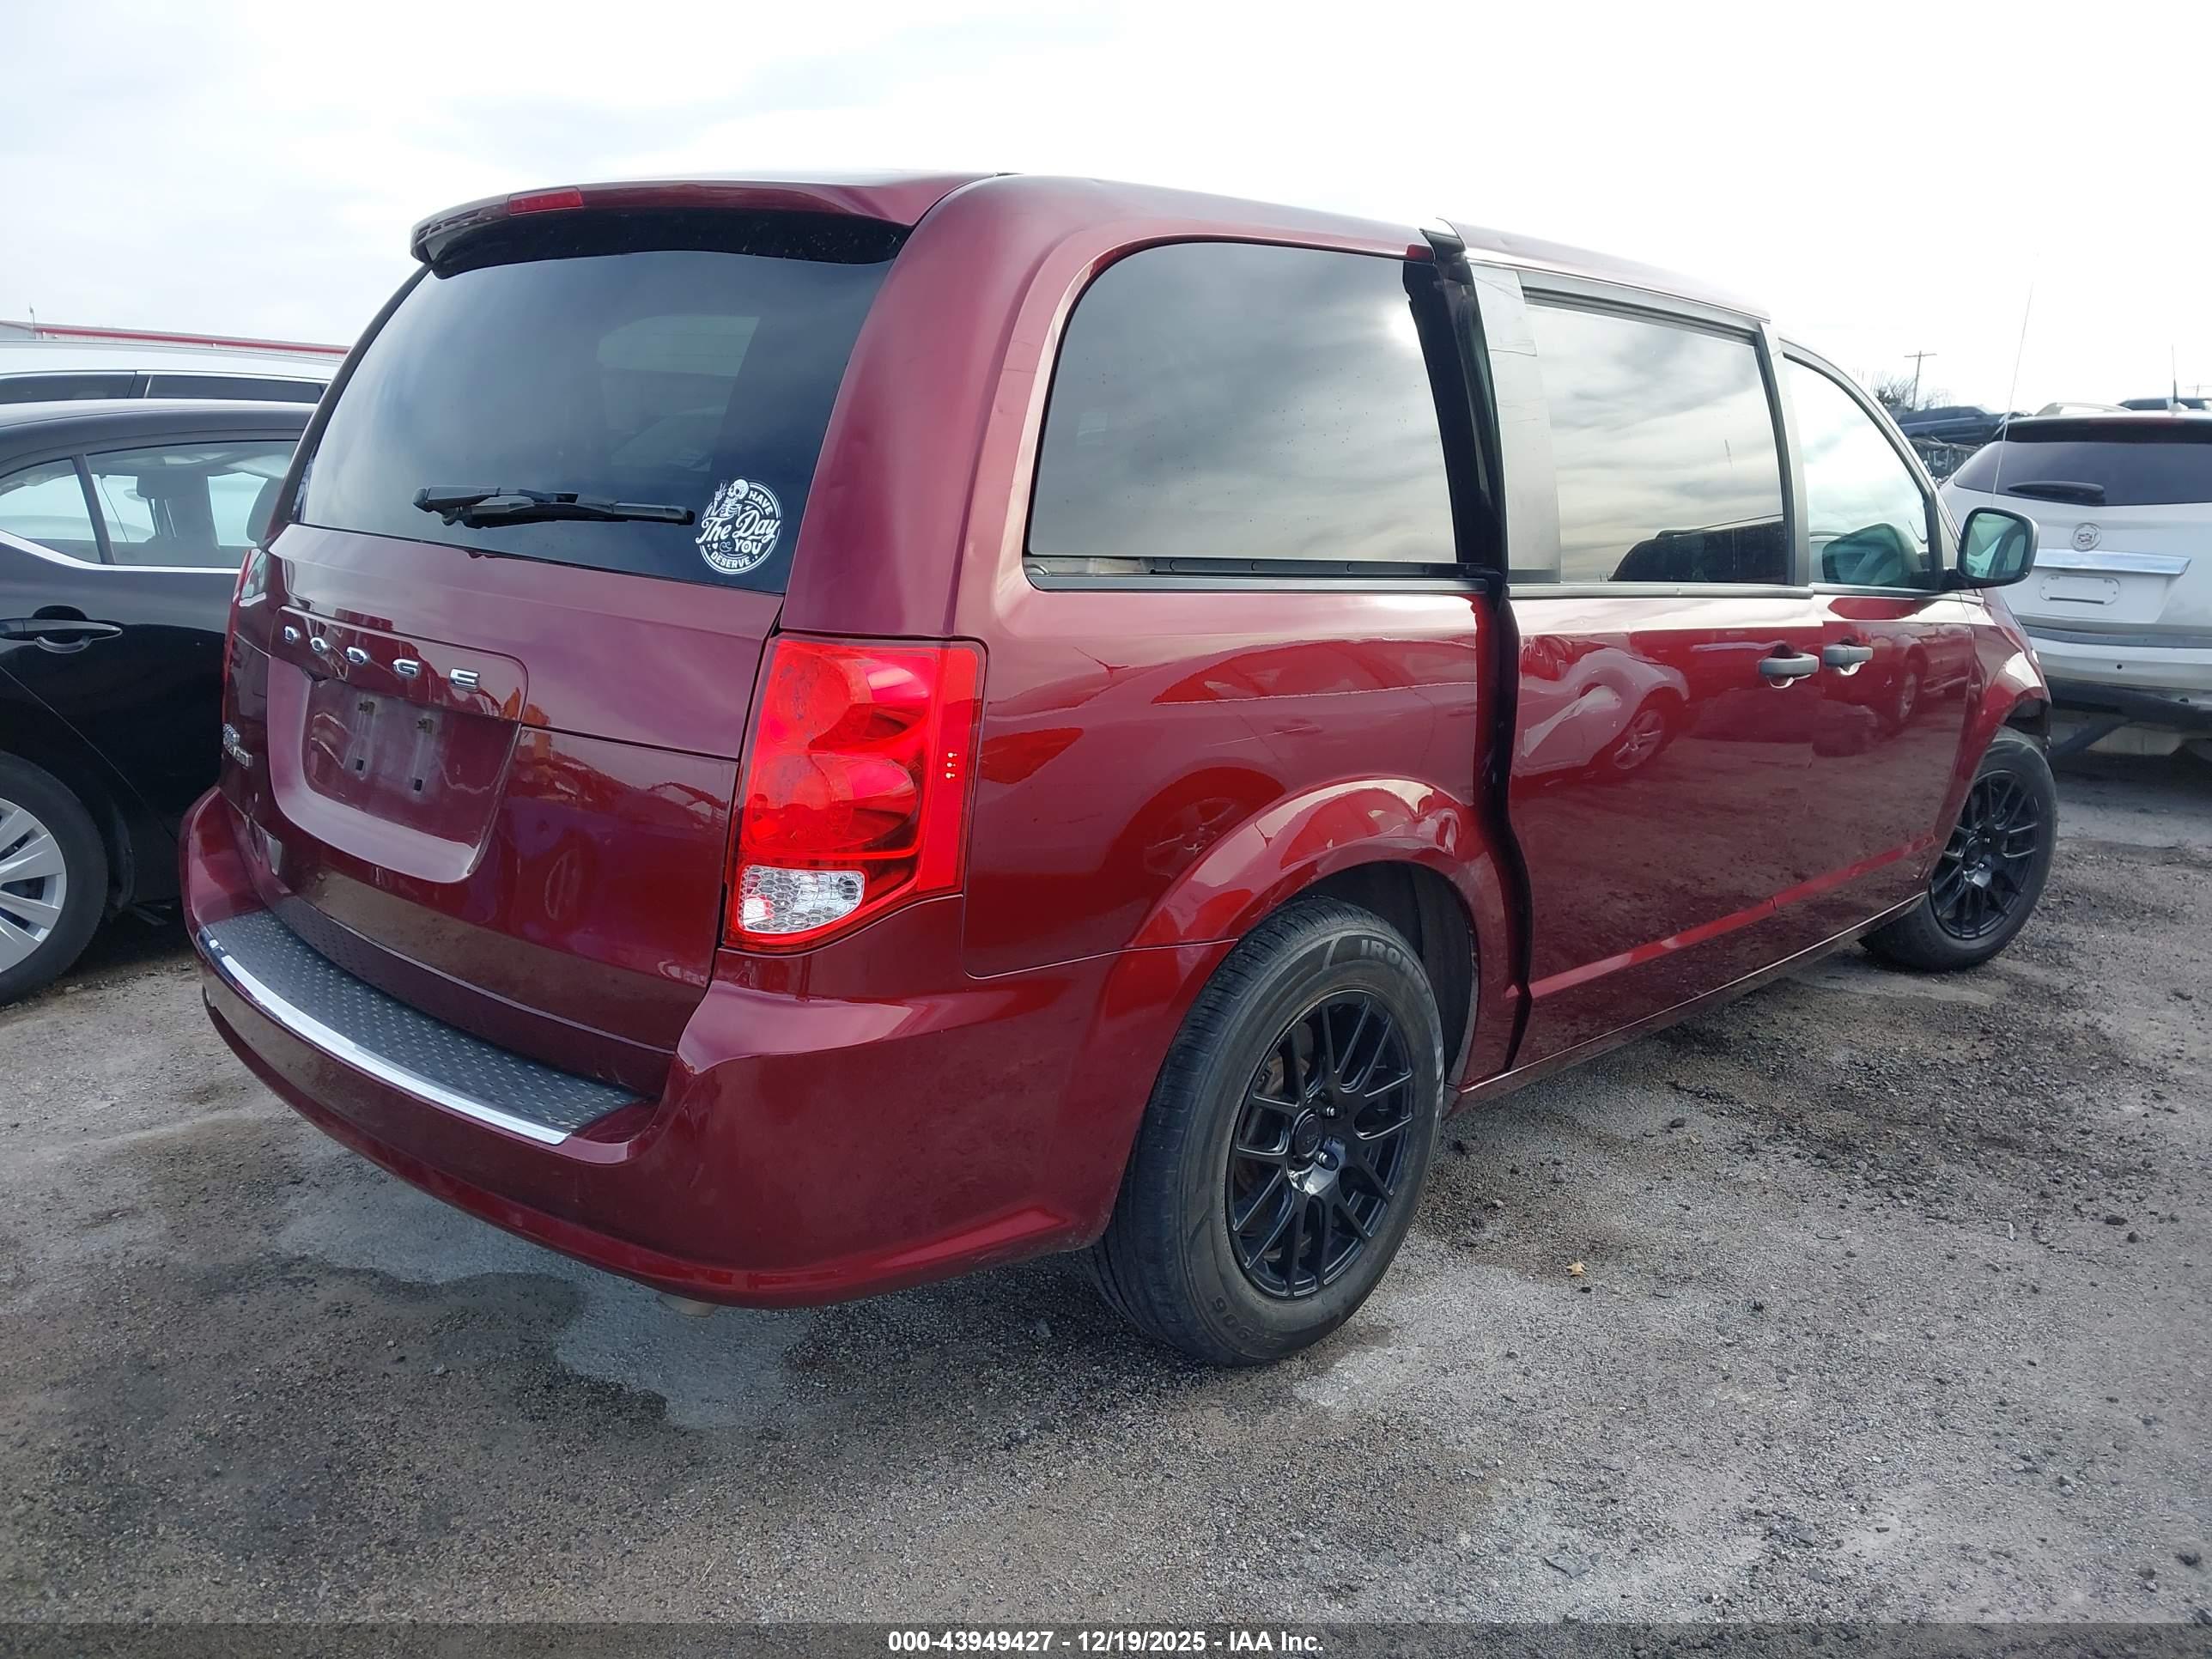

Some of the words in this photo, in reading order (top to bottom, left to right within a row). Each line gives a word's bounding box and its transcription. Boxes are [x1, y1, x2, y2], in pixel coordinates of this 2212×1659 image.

[749, 490, 774, 516] HAVE
[696, 515, 732, 544] The
[732, 510, 781, 544] Day
[710, 550, 751, 568] DESERVE
[734, 538, 763, 555] YOU
[283, 625, 481, 691] DODGE
